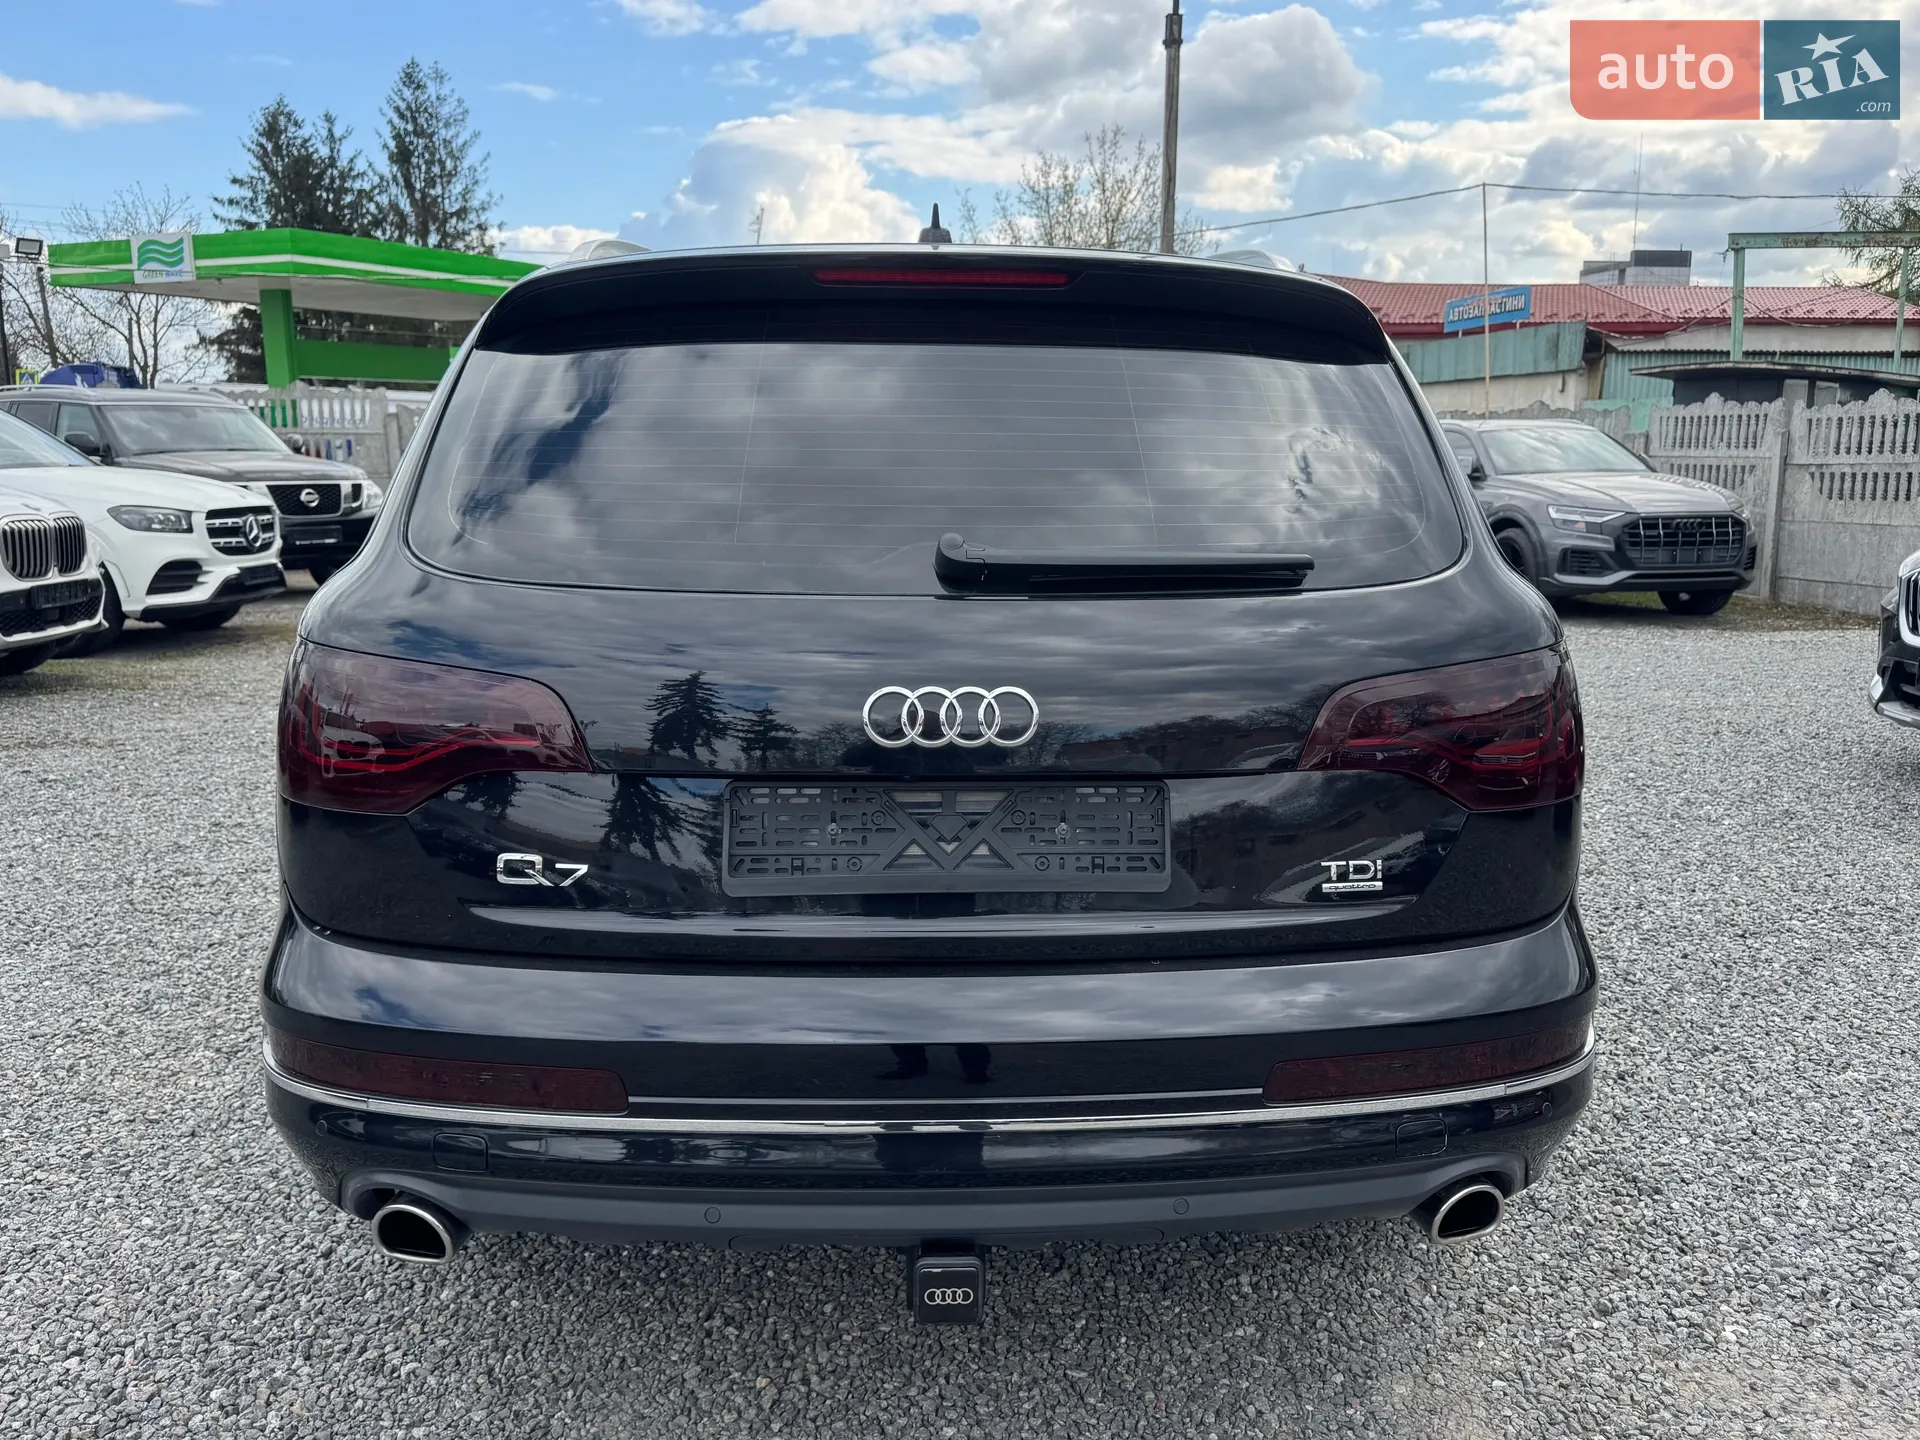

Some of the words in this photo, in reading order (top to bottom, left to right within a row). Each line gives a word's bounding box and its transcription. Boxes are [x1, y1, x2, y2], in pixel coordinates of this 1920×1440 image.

[142, 269, 164, 279] GREEN
[164, 268, 184, 279] WAVE
[496, 852, 589, 887] Q7
[1320, 859, 1383, 881] TDI
[1328, 883, 1377, 891] quattro
